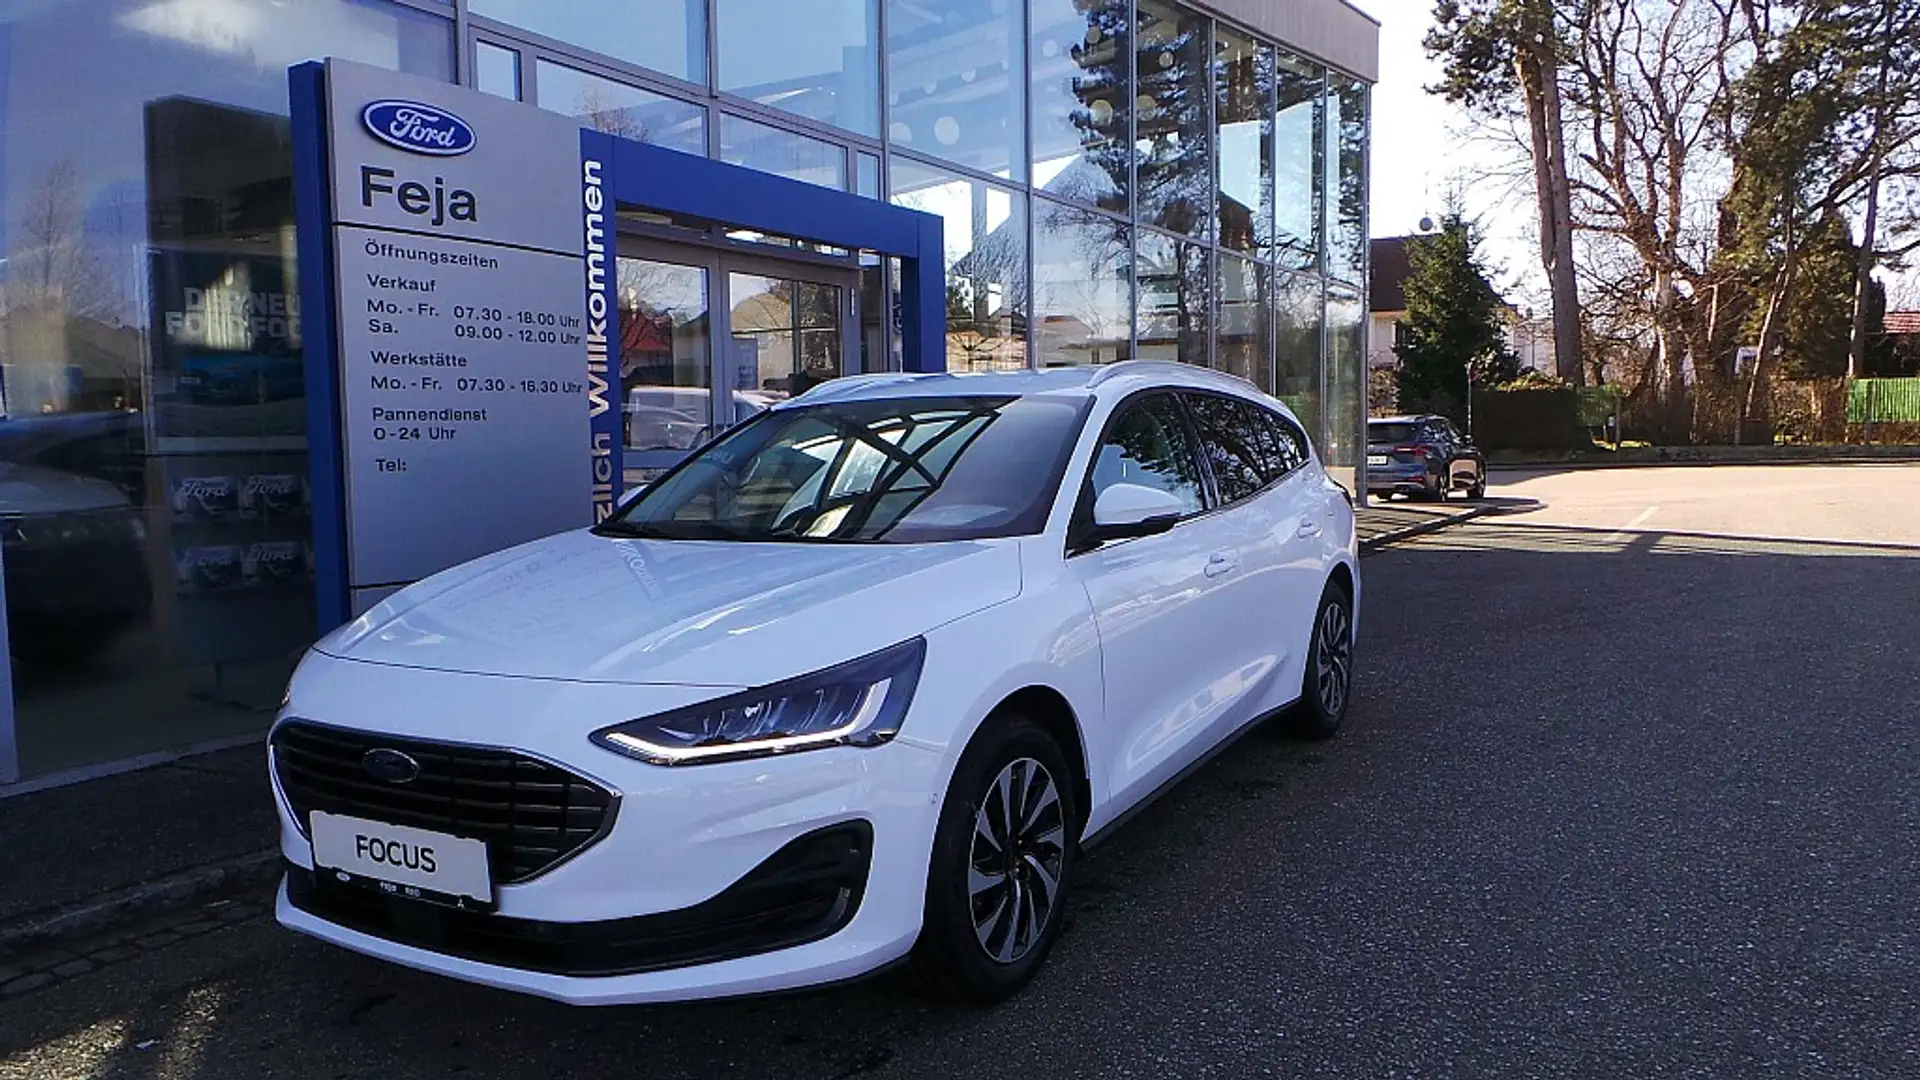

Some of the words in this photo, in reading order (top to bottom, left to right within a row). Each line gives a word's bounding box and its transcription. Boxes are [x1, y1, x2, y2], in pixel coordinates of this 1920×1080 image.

[390, 108, 456, 148] Ford
[361, 165, 478, 226] Feja
[365, 238, 499, 269] Öffnungszeiten
[366, 273, 436, 292] Verkauf
[584, 160, 609, 418] Willkommen
[453, 305, 502, 322] 07.30
[517, 311, 555, 326] 18.00
[559, 315, 580, 328] Uhr
[368, 319, 398, 333] Sa.
[455, 324, 503, 340] 09.00
[518, 330, 556, 343] 12.00
[560, 332, 580, 345] Uhr
[370, 350, 467, 367] Werkstätte
[457, 378, 505, 391] 07.30
[520, 381, 558, 393] 16.30
[562, 381, 582, 394] Uhr
[372, 407, 487, 421] Pannendienst
[429, 426, 456, 440] Uhr
[375, 458, 407, 472] Tel:
[355, 834, 436, 872] FOCUS
